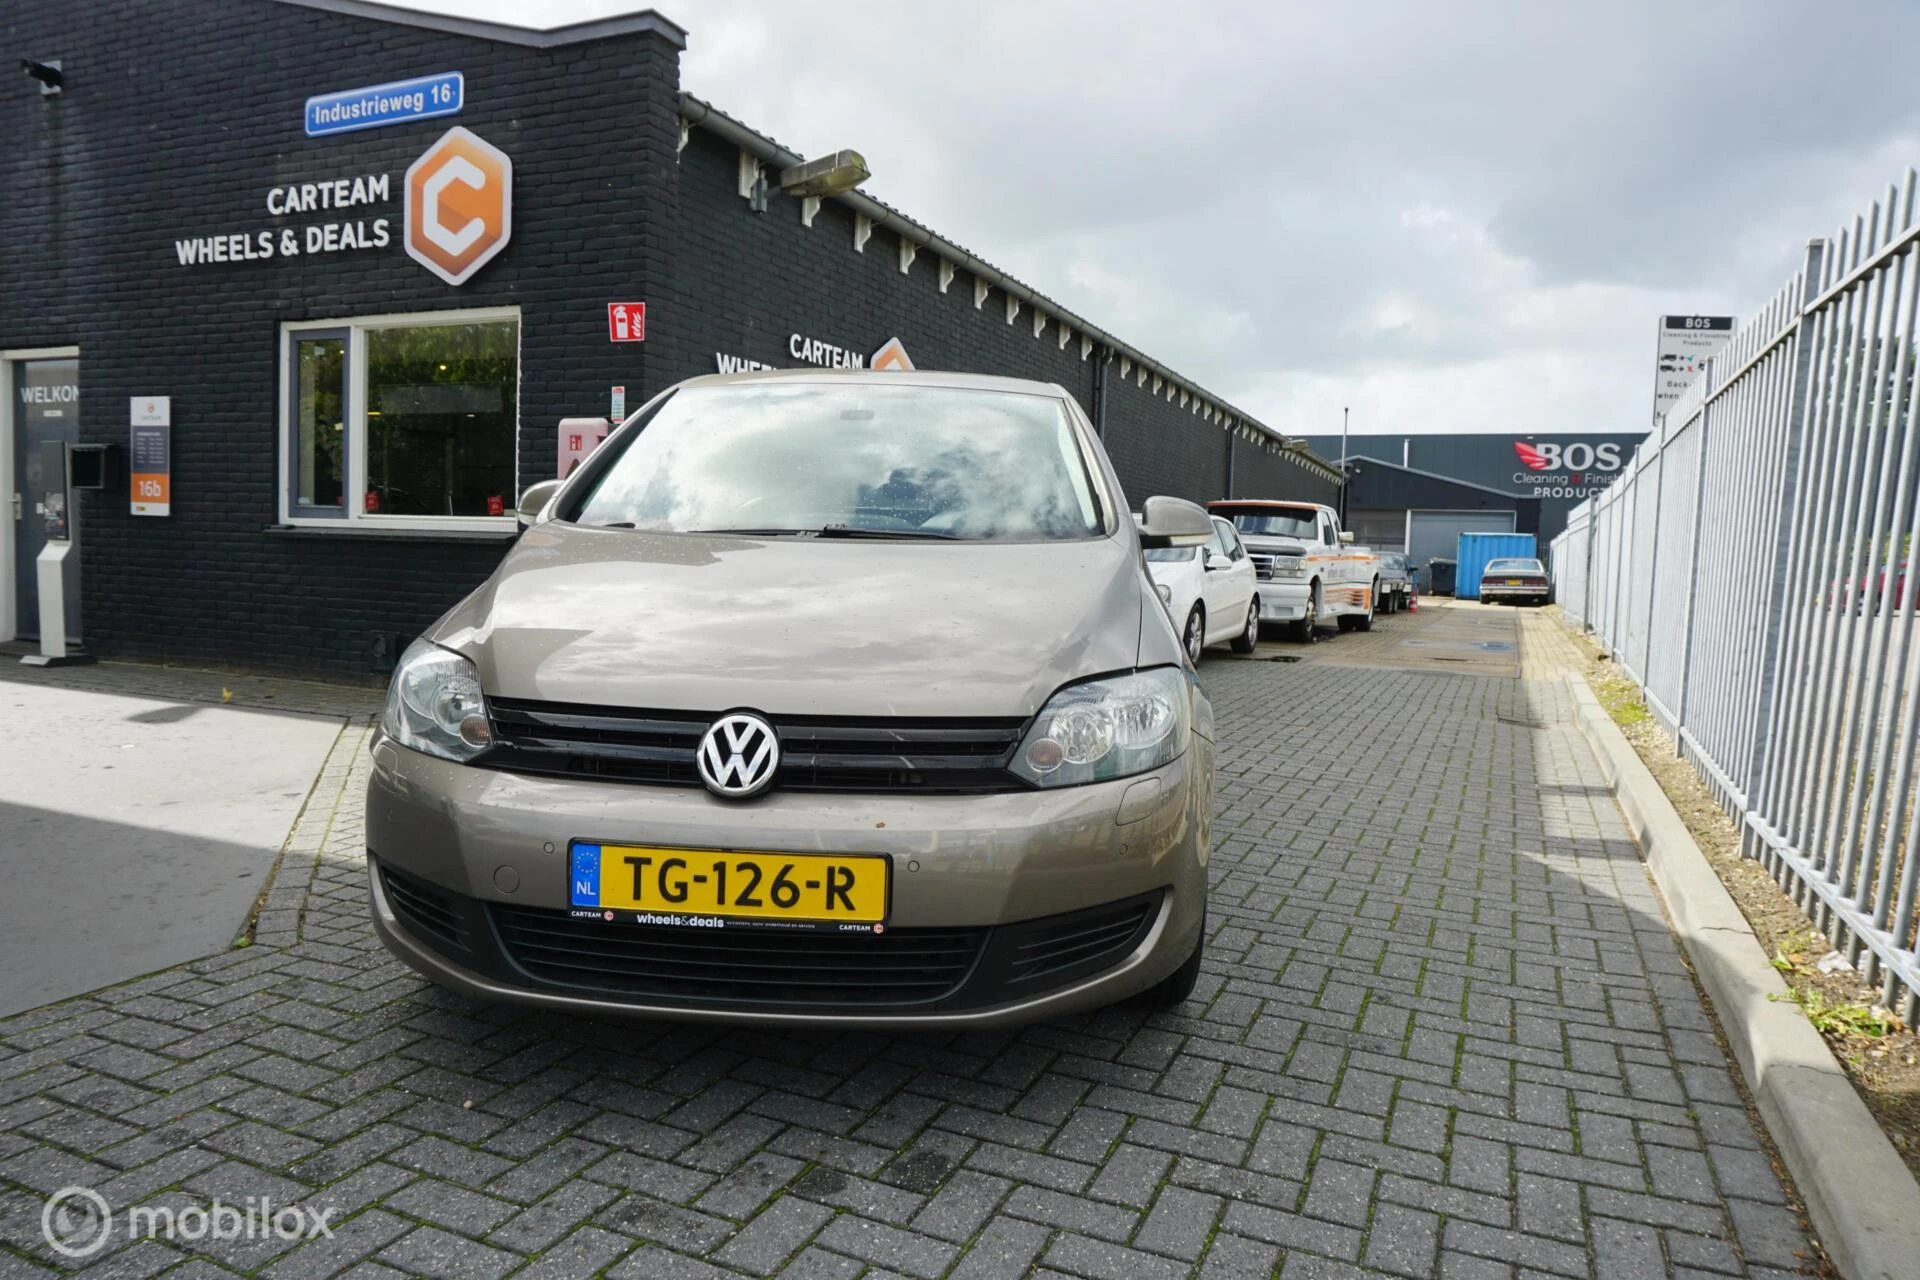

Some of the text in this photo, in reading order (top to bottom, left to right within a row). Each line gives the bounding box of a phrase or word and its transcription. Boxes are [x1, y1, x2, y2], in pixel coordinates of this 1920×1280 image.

[315, 83, 451, 124] Industrieweg 16
[266, 174, 389, 215] CARTEAM
[175, 219, 390, 266] WHEELS & DEALS
[1685, 318, 1711, 328] BOS
[790, 333, 863, 369] CARTEAM
[1536, 443, 1621, 471] BOS
[138, 480, 162, 497] 16b
[1512, 472, 1569, 486] Cleaning
[576, 881, 596, 896] NL
[623, 857, 856, 911] TG-126-R
[571, 910, 601, 918] CARTEAM
[637, 913, 725, 928] wheels&deals
